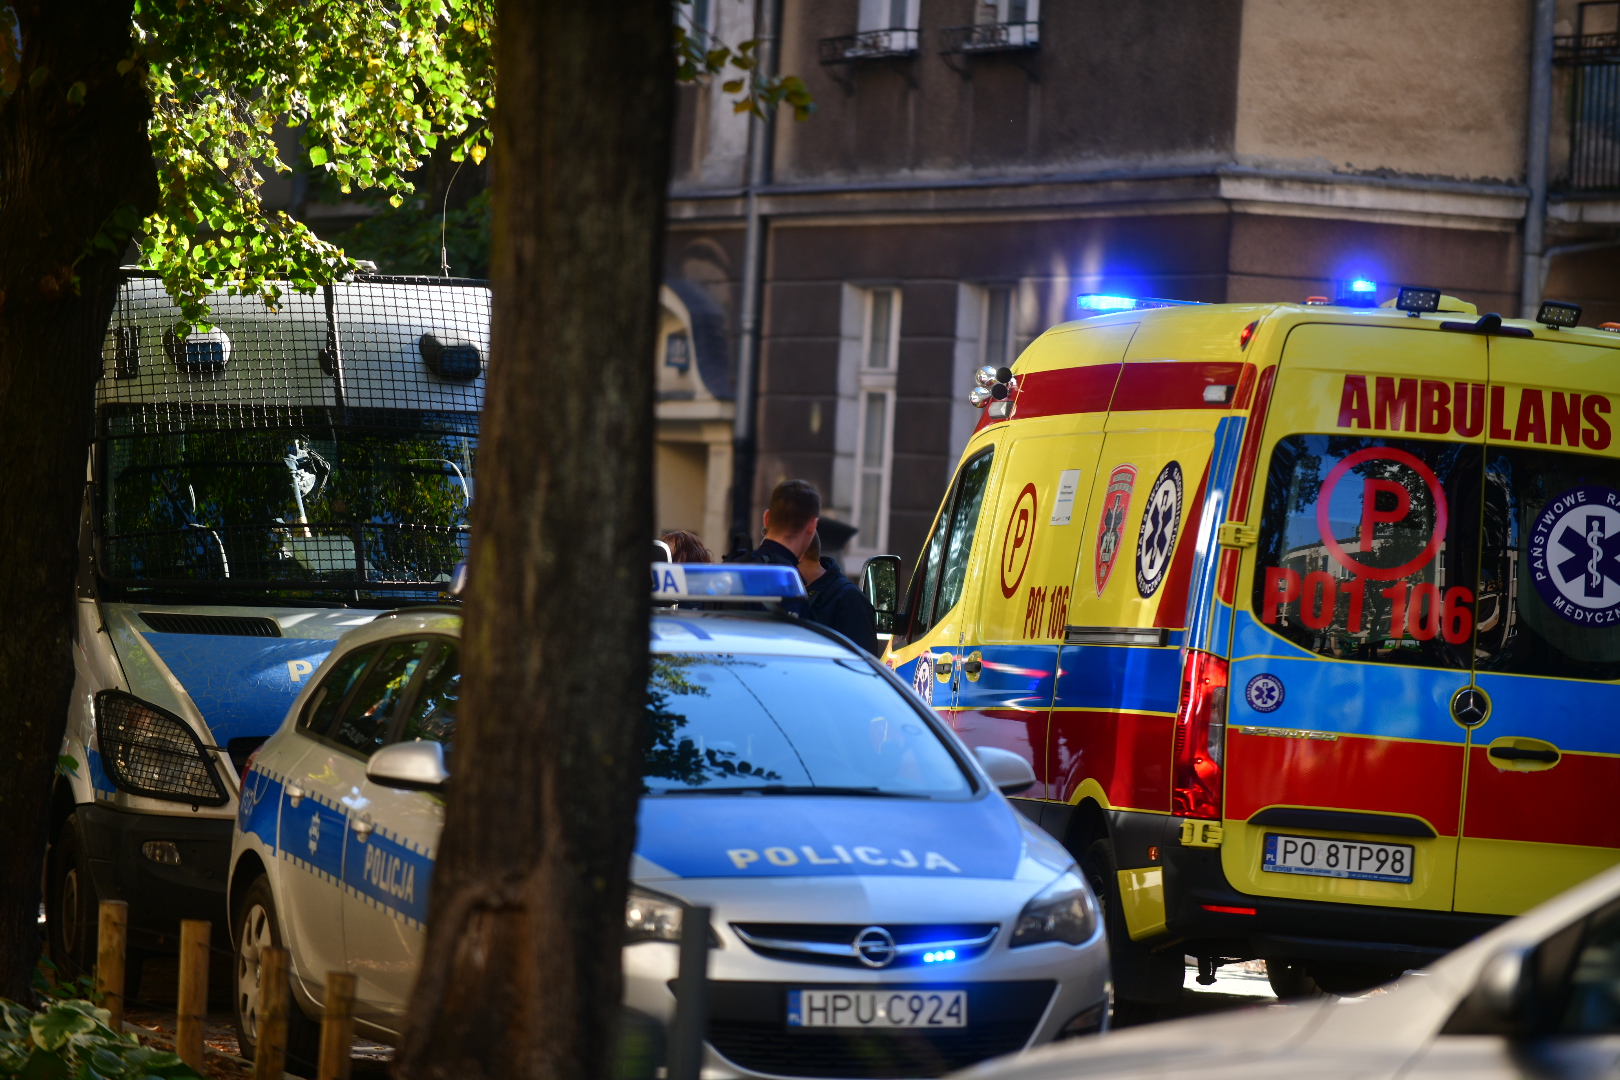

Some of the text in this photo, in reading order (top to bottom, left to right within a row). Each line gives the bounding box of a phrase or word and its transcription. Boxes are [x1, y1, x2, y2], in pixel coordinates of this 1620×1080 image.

[1337, 374, 1612, 451] AMBULANS
[1008, 509, 1028, 573] P
[1360, 478, 1410, 552] P
[1531, 491, 1587, 581] PAŃSTWOWE
[1047, 586, 1069, 639] 106
[1383, 580, 1474, 645] 106
[1241, 726, 1336, 741] SPRINTER
[363, 843, 415, 904] POLICJA
[726, 846, 962, 873] POLICJA
[1266, 839, 1404, 874] PL PO 8TP98
[807, 994, 875, 1024] HPU
[887, 994, 962, 1025] C924
